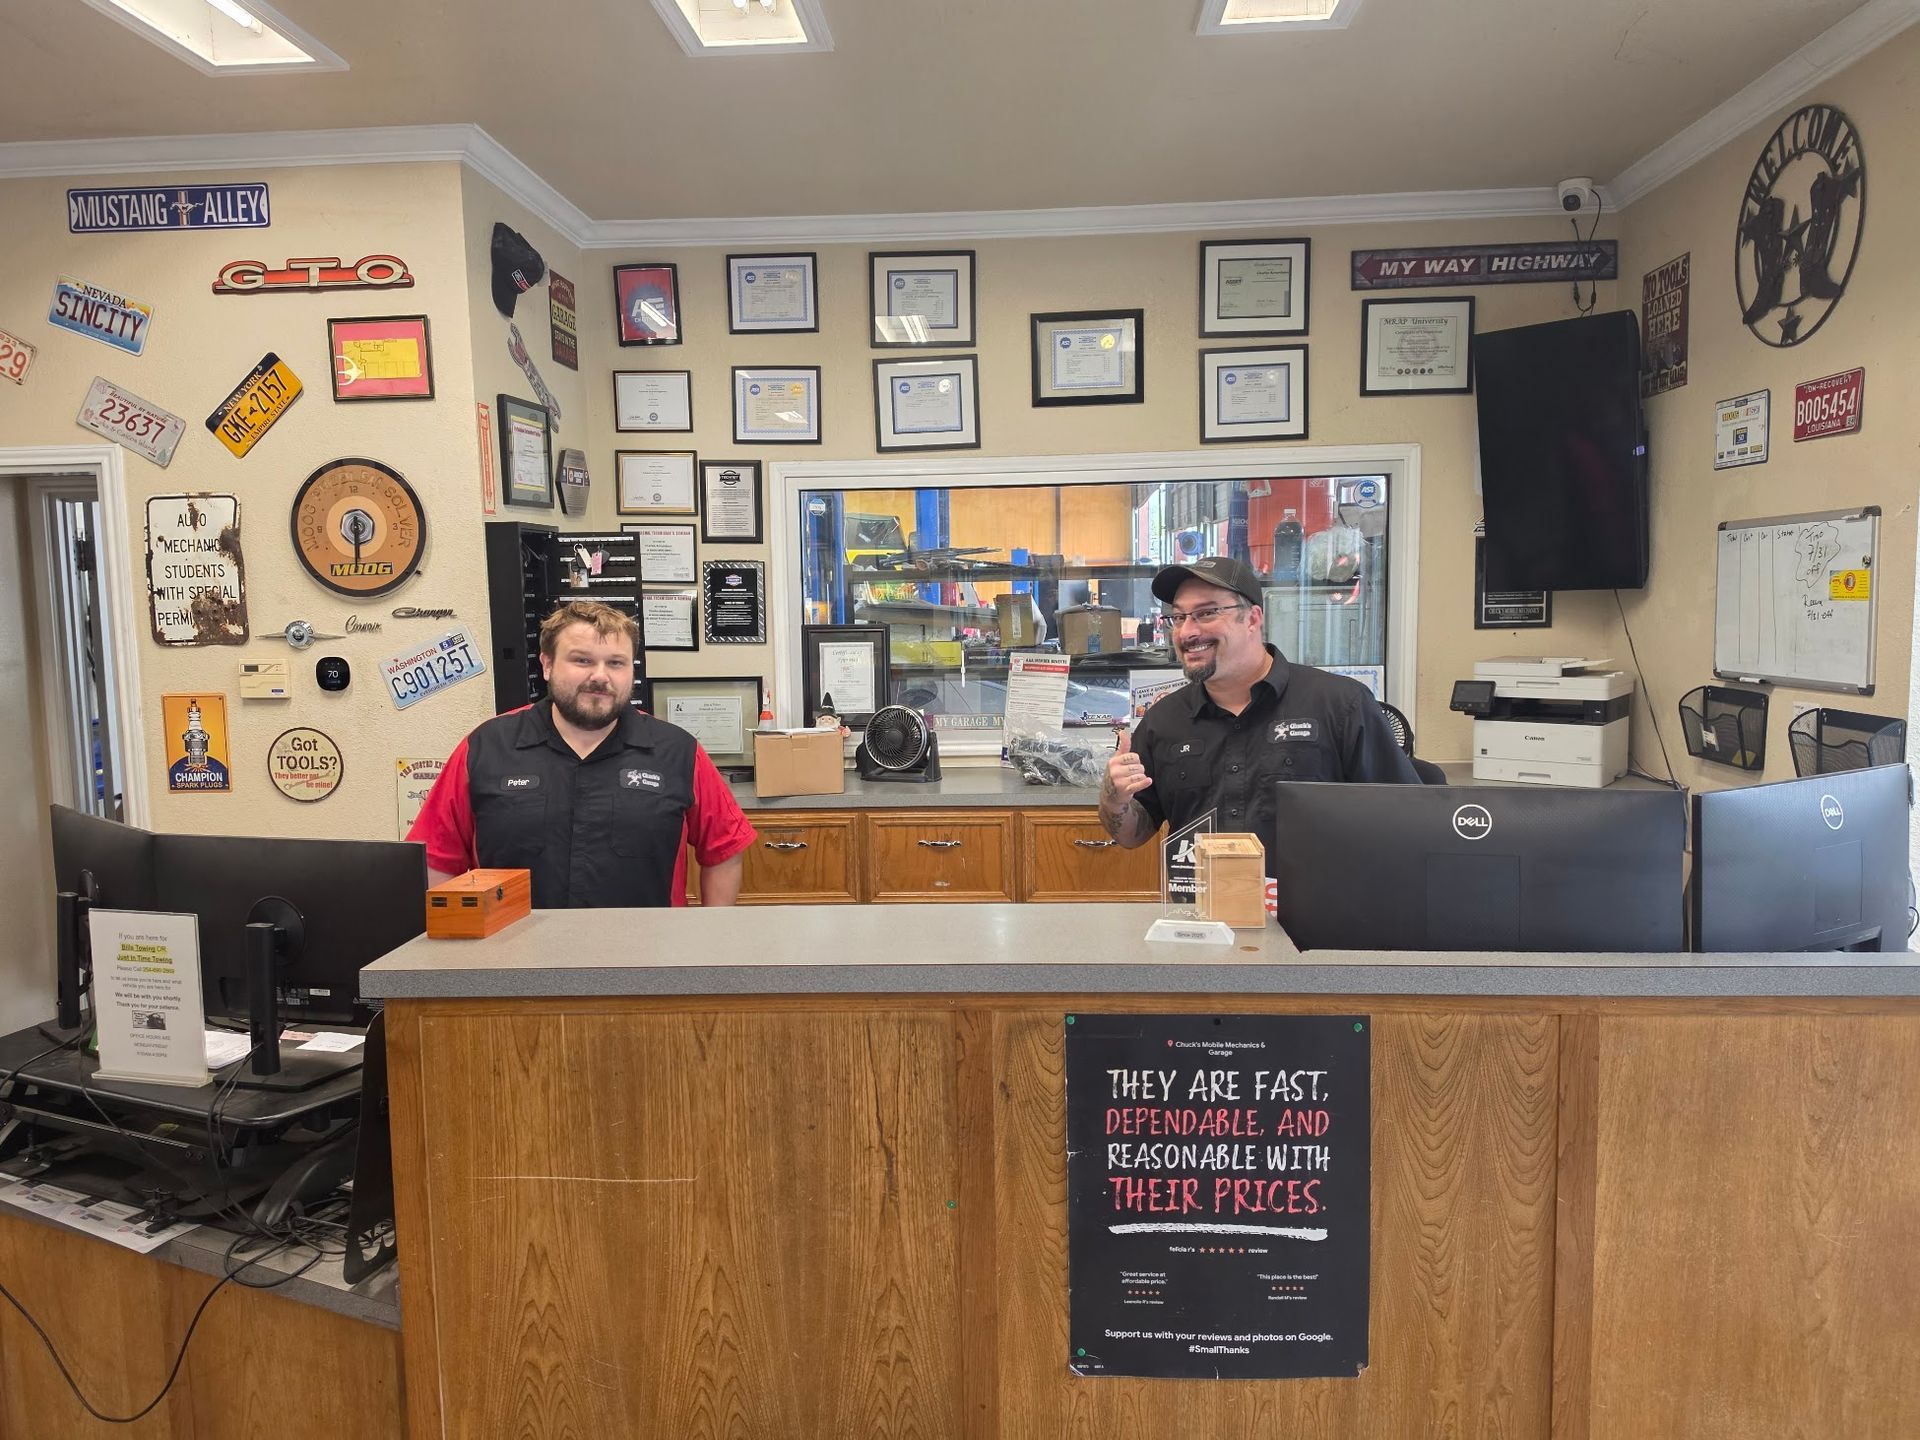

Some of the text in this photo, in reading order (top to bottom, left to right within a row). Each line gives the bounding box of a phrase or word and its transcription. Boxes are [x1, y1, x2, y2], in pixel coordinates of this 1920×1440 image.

[1750, 107, 1856, 200] WELCOME
[78, 190, 261, 228] MUSTANG ALLEY
[1379, 258, 1476, 276] MY WAY
[1490, 252, 1601, 272] HIGHWAY
[222, 258, 408, 290] GTO
[83, 285, 127, 309] NEVADA
[1648, 289, 1682, 320] LOANED
[55, 291, 144, 342] SINCITY
[1412, 317, 1449, 326] University
[1648, 309, 1680, 339] HERE
[223, 370, 262, 413] NEW YORK
[109, 390, 138, 409] BEAUTIFUL
[222, 369, 287, 443] GKE 2157
[99, 398, 166, 444] 23637
[250, 400, 288, 440] EMPIRE STATE
[1807, 419, 1841, 435] LOUISIANA
[349, 485, 359, 494] 12
[177, 513, 207, 528] AUO
[301, 503, 320, 552] MOOG
[384, 486, 414, 549] SOLVER
[392, 523, 399, 531] 3
[165, 564, 226, 579] STUDENTS
[332, 563, 392, 576] MOOG
[1807, 562, 1821, 575] off
[158, 612, 193, 626] PERMI
[387, 647, 438, 675] WASHINGTON
[327, 670, 339, 678] 70
[391, 643, 475, 699] C90125T
[934, 717, 949, 727] MY
[951, 716, 989, 727] GARAGE
[291, 737, 319, 752] Got
[1180, 744, 1190, 753] JR
[276, 755, 338, 770] TOOLS?
[175, 772, 223, 783] CHAMPION
[274, 772, 289, 780] They
[290, 772, 308, 780] better
[507, 778, 530, 787] Peter
[200, 781, 223, 789] PLUGS
[1824, 807, 1841, 818] DELL
[1458, 817, 1488, 827] DELL
[1168, 883, 1208, 894] Member
[135, 944, 156, 953] Towing
[152, 955, 173, 964] Towing
[1208, 1049, 1233, 1057] Garage
[1106, 1069, 1329, 1102] THEY ARE FAST,
[1105, 1108, 1331, 1138] DEPENDABLE, AND
[1107, 1143, 1331, 1172] REASONABLE WITH
[1108, 1177, 1328, 1215] THEIR PRICES.
[1104, 1329, 1141, 1339] Support
[1154, 1331, 1174, 1339] with
[1175, 1332, 1196, 1341] your
[1197, 1332, 1233, 1341] reviews
[1233, 1333, 1251, 1341] and
[1252, 1333, 1284, 1343] photos
[1298, 1332, 1334, 1343] Google.
[1188, 1345, 1250, 1354] #SmallThanks
